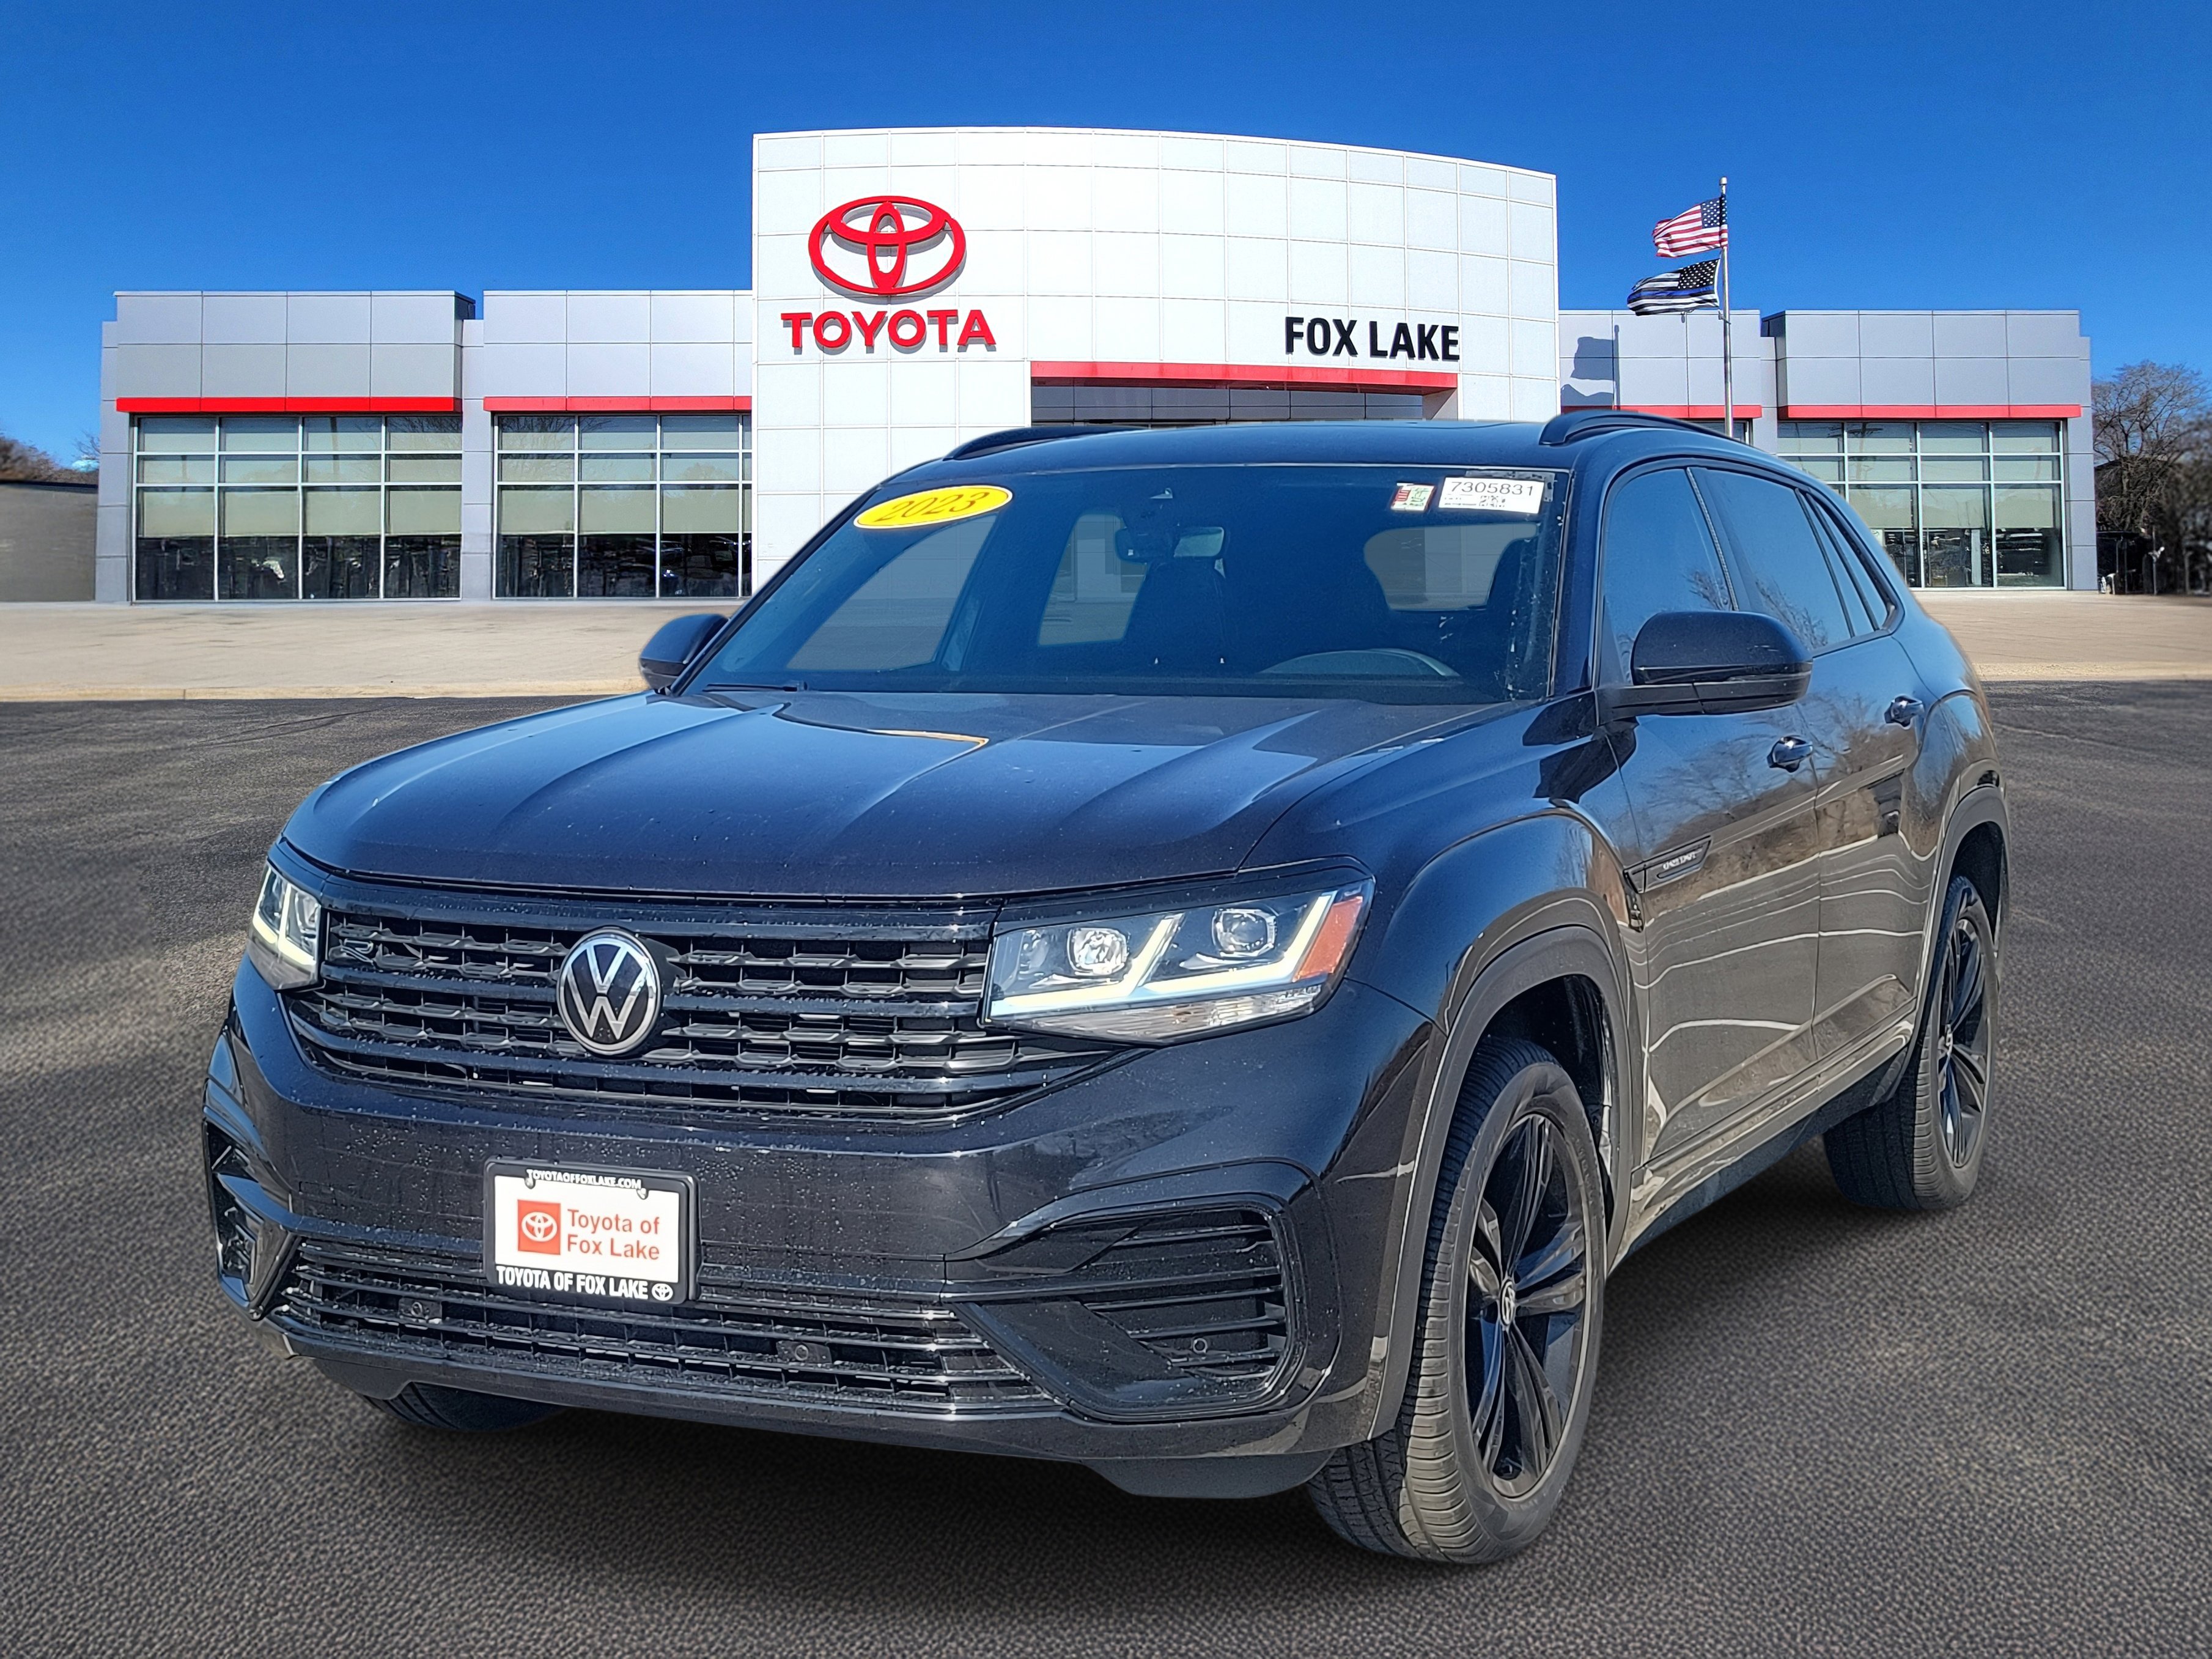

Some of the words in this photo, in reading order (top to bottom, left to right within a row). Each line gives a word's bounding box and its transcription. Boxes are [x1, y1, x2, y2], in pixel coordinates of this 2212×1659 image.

[781, 309, 995, 354] TOYOTA
[1285, 316, 1357, 357] FOX
[1368, 321, 1459, 361] LAKE
[1451, 482, 1533, 496] 7305831
[874, 492, 990, 522] 2023
[526, 1169, 641, 1189] TOYOTAOFFOXLAKE.COM
[567, 1208, 632, 1234] Toyota
[640, 1217, 660, 1234] of
[567, 1234, 603, 1255] Fox
[610, 1238, 660, 1260] Lake
[496, 1266, 551, 1289] TOYOTA
[554, 1272, 573, 1291] OF
[577, 1275, 606, 1295] FOX
[609, 1277, 648, 1299] LAKE
